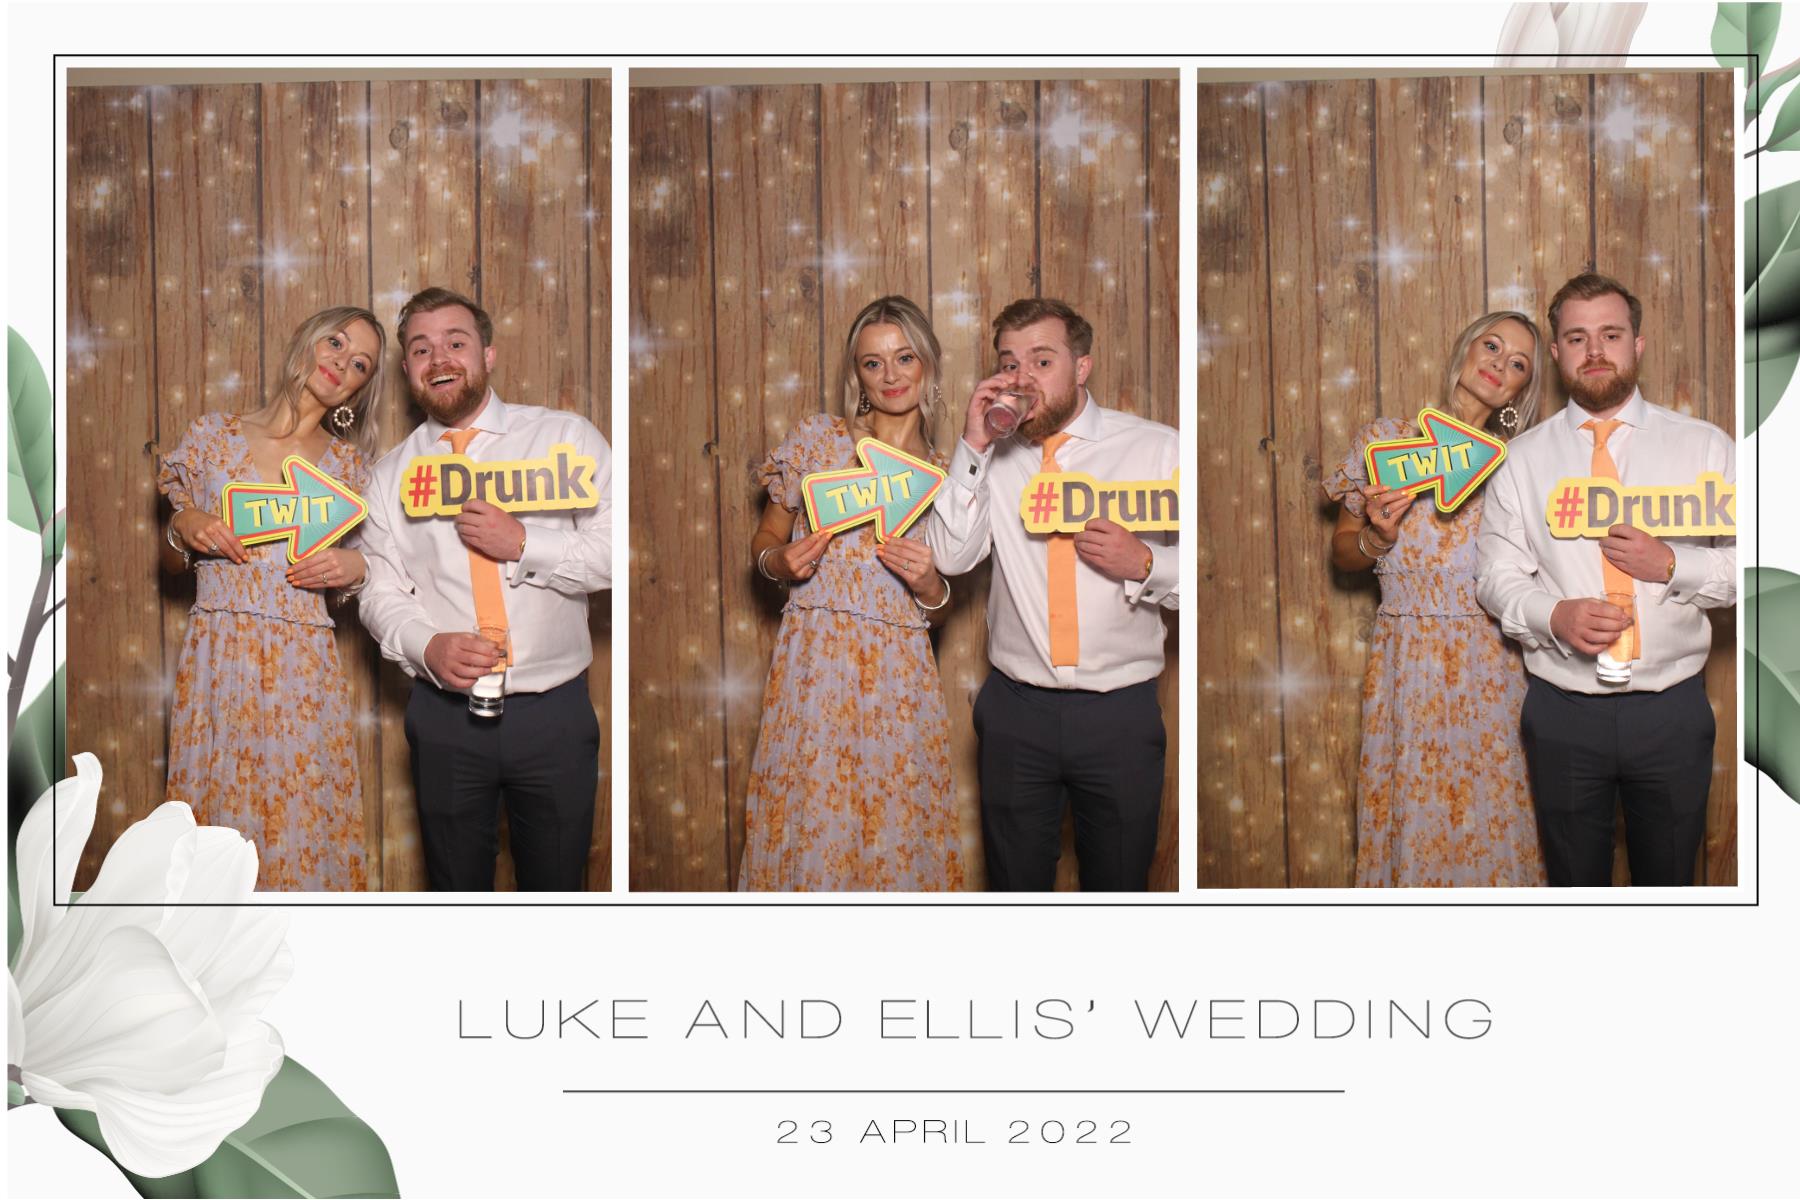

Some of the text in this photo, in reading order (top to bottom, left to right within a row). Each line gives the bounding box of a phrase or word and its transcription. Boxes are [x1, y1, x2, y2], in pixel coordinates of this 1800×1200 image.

[408, 452, 590, 507] #Drunk
[1387, 440, 1473, 482] TWIT
[244, 494, 336, 528] TWIT
[825, 470, 914, 514] TWIT
[1554, 480, 1735, 529] #Drunk
